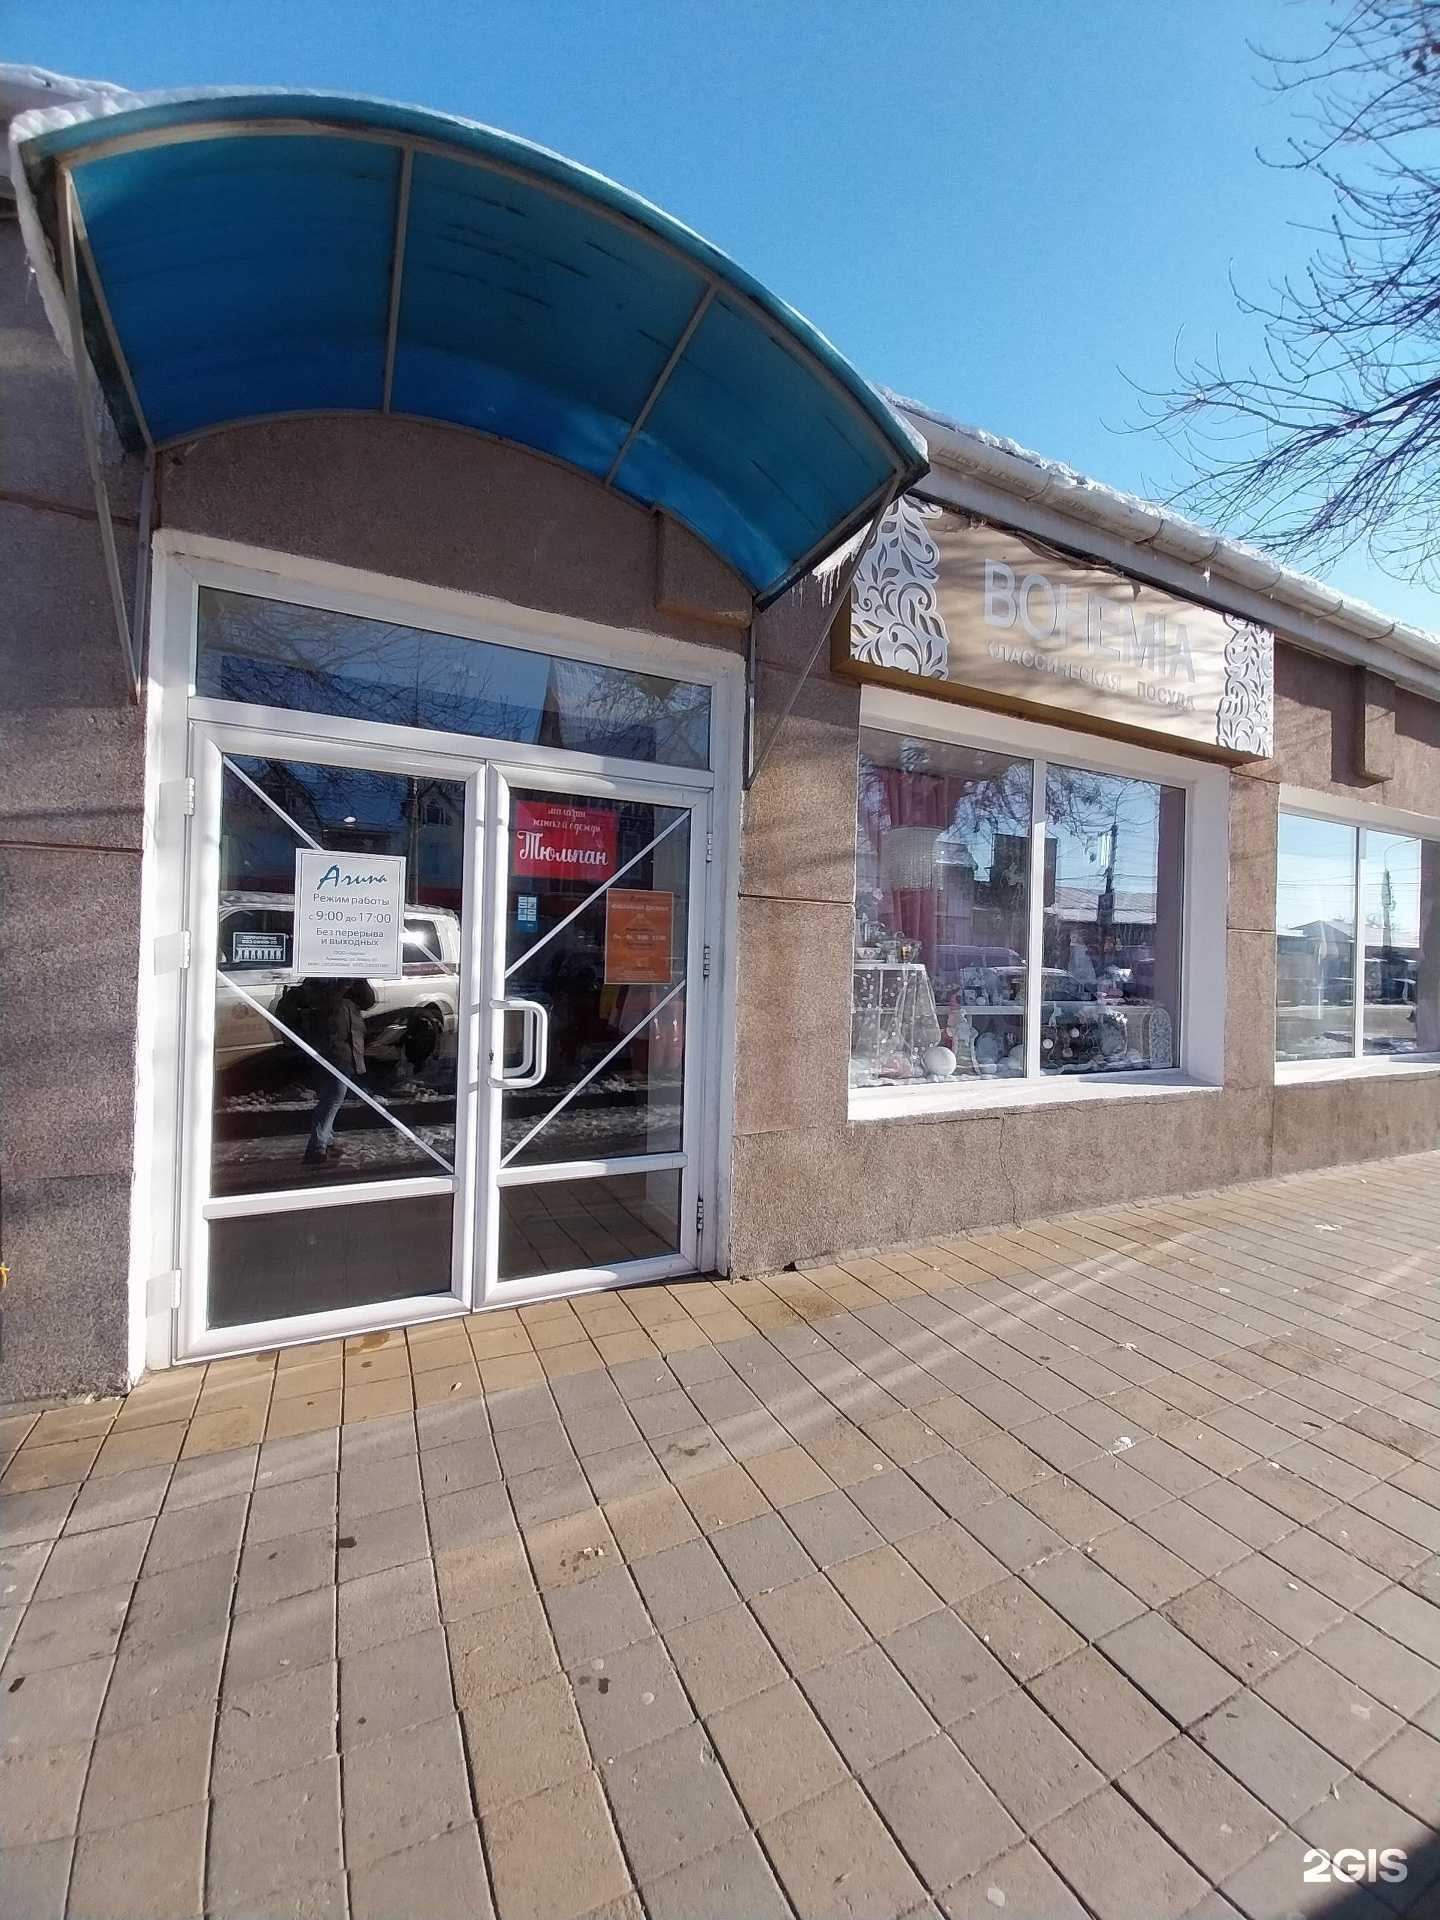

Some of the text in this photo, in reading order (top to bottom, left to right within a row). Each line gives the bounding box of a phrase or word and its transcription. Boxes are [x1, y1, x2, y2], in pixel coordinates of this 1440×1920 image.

[984, 558, 1196, 683] BOHEMIA
[517, 830, 608, 866] Тюльпан
[313, 893, 390, 905] Режим работы
[316, 910, 344, 921] 9:00
[359, 912, 391, 924] 17:00
[316, 927, 384, 938] Без перерыва
[329, 938, 379, 947] выходных
